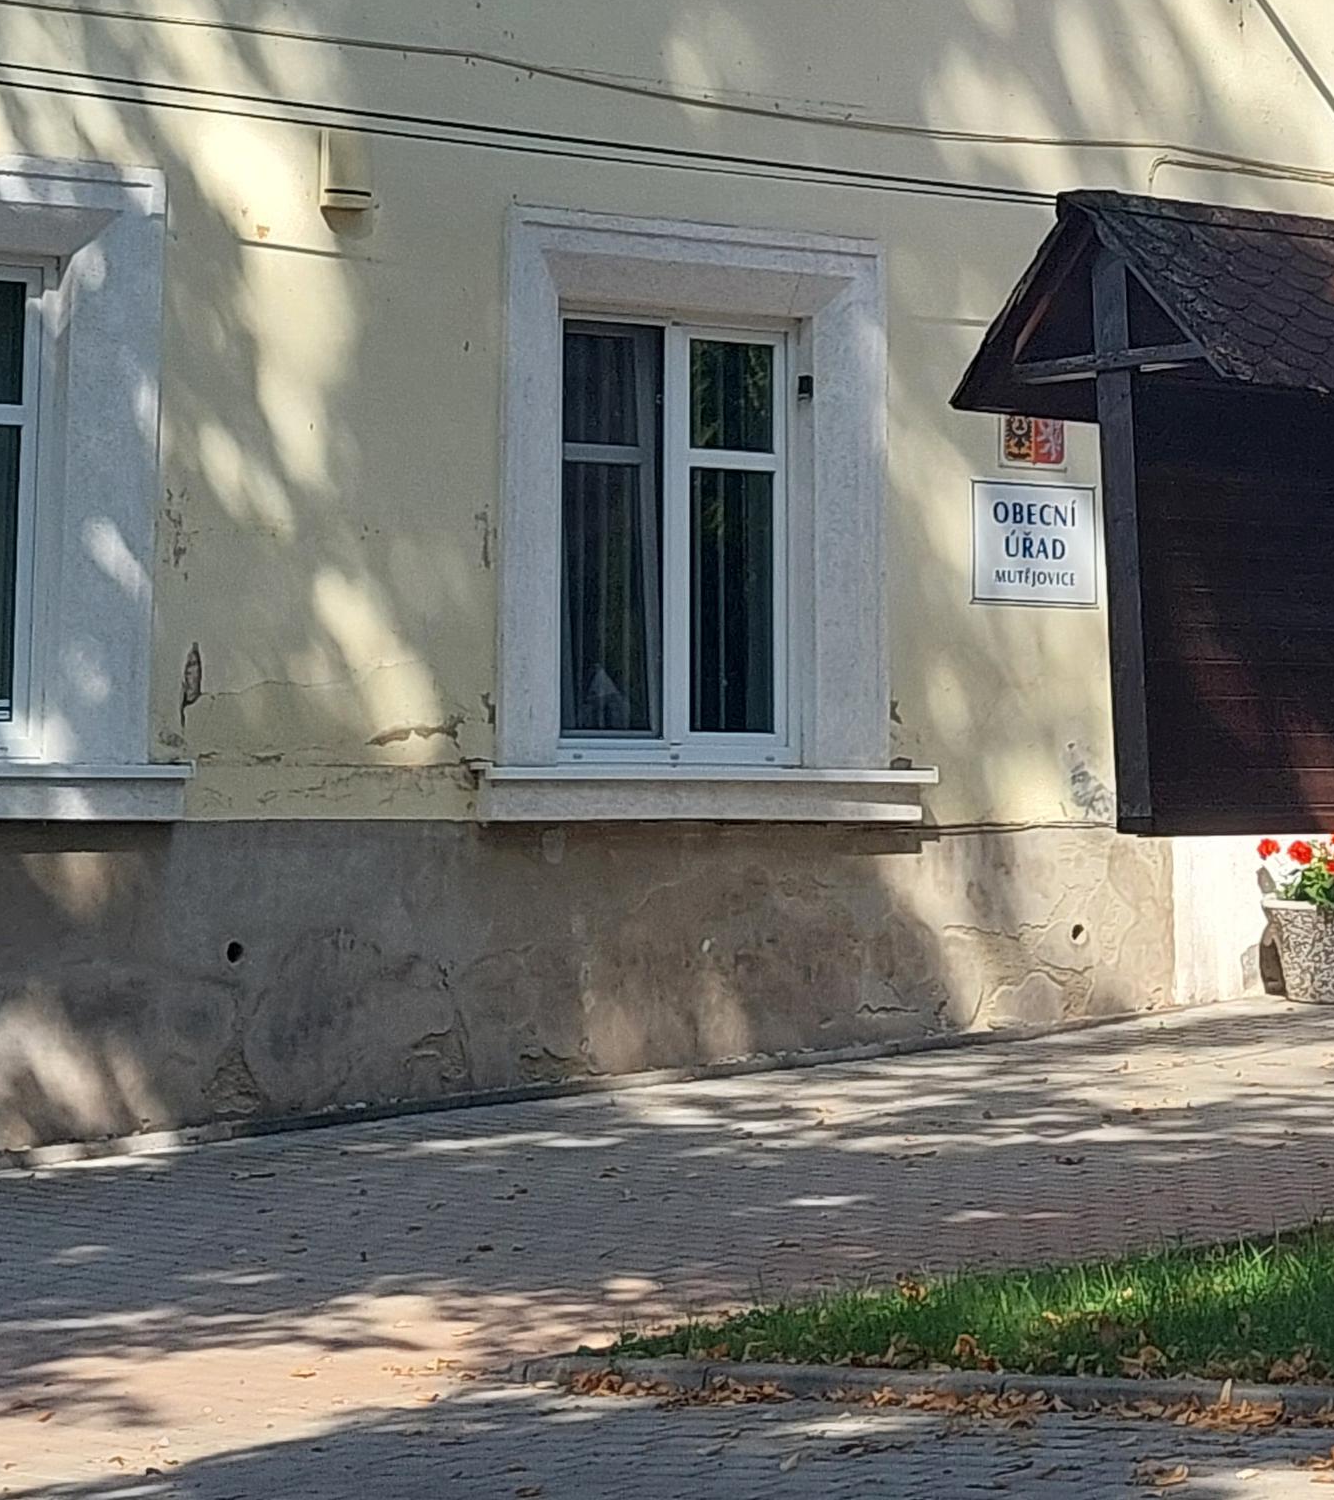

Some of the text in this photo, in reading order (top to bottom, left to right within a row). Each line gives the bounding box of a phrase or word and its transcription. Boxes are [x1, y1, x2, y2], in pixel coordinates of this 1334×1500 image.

[993, 499, 1077, 528] OBECNÍ
[1004, 528, 1066, 561] ÚŘAD
[994, 567, 1076, 588] MUTĚJOVICE
